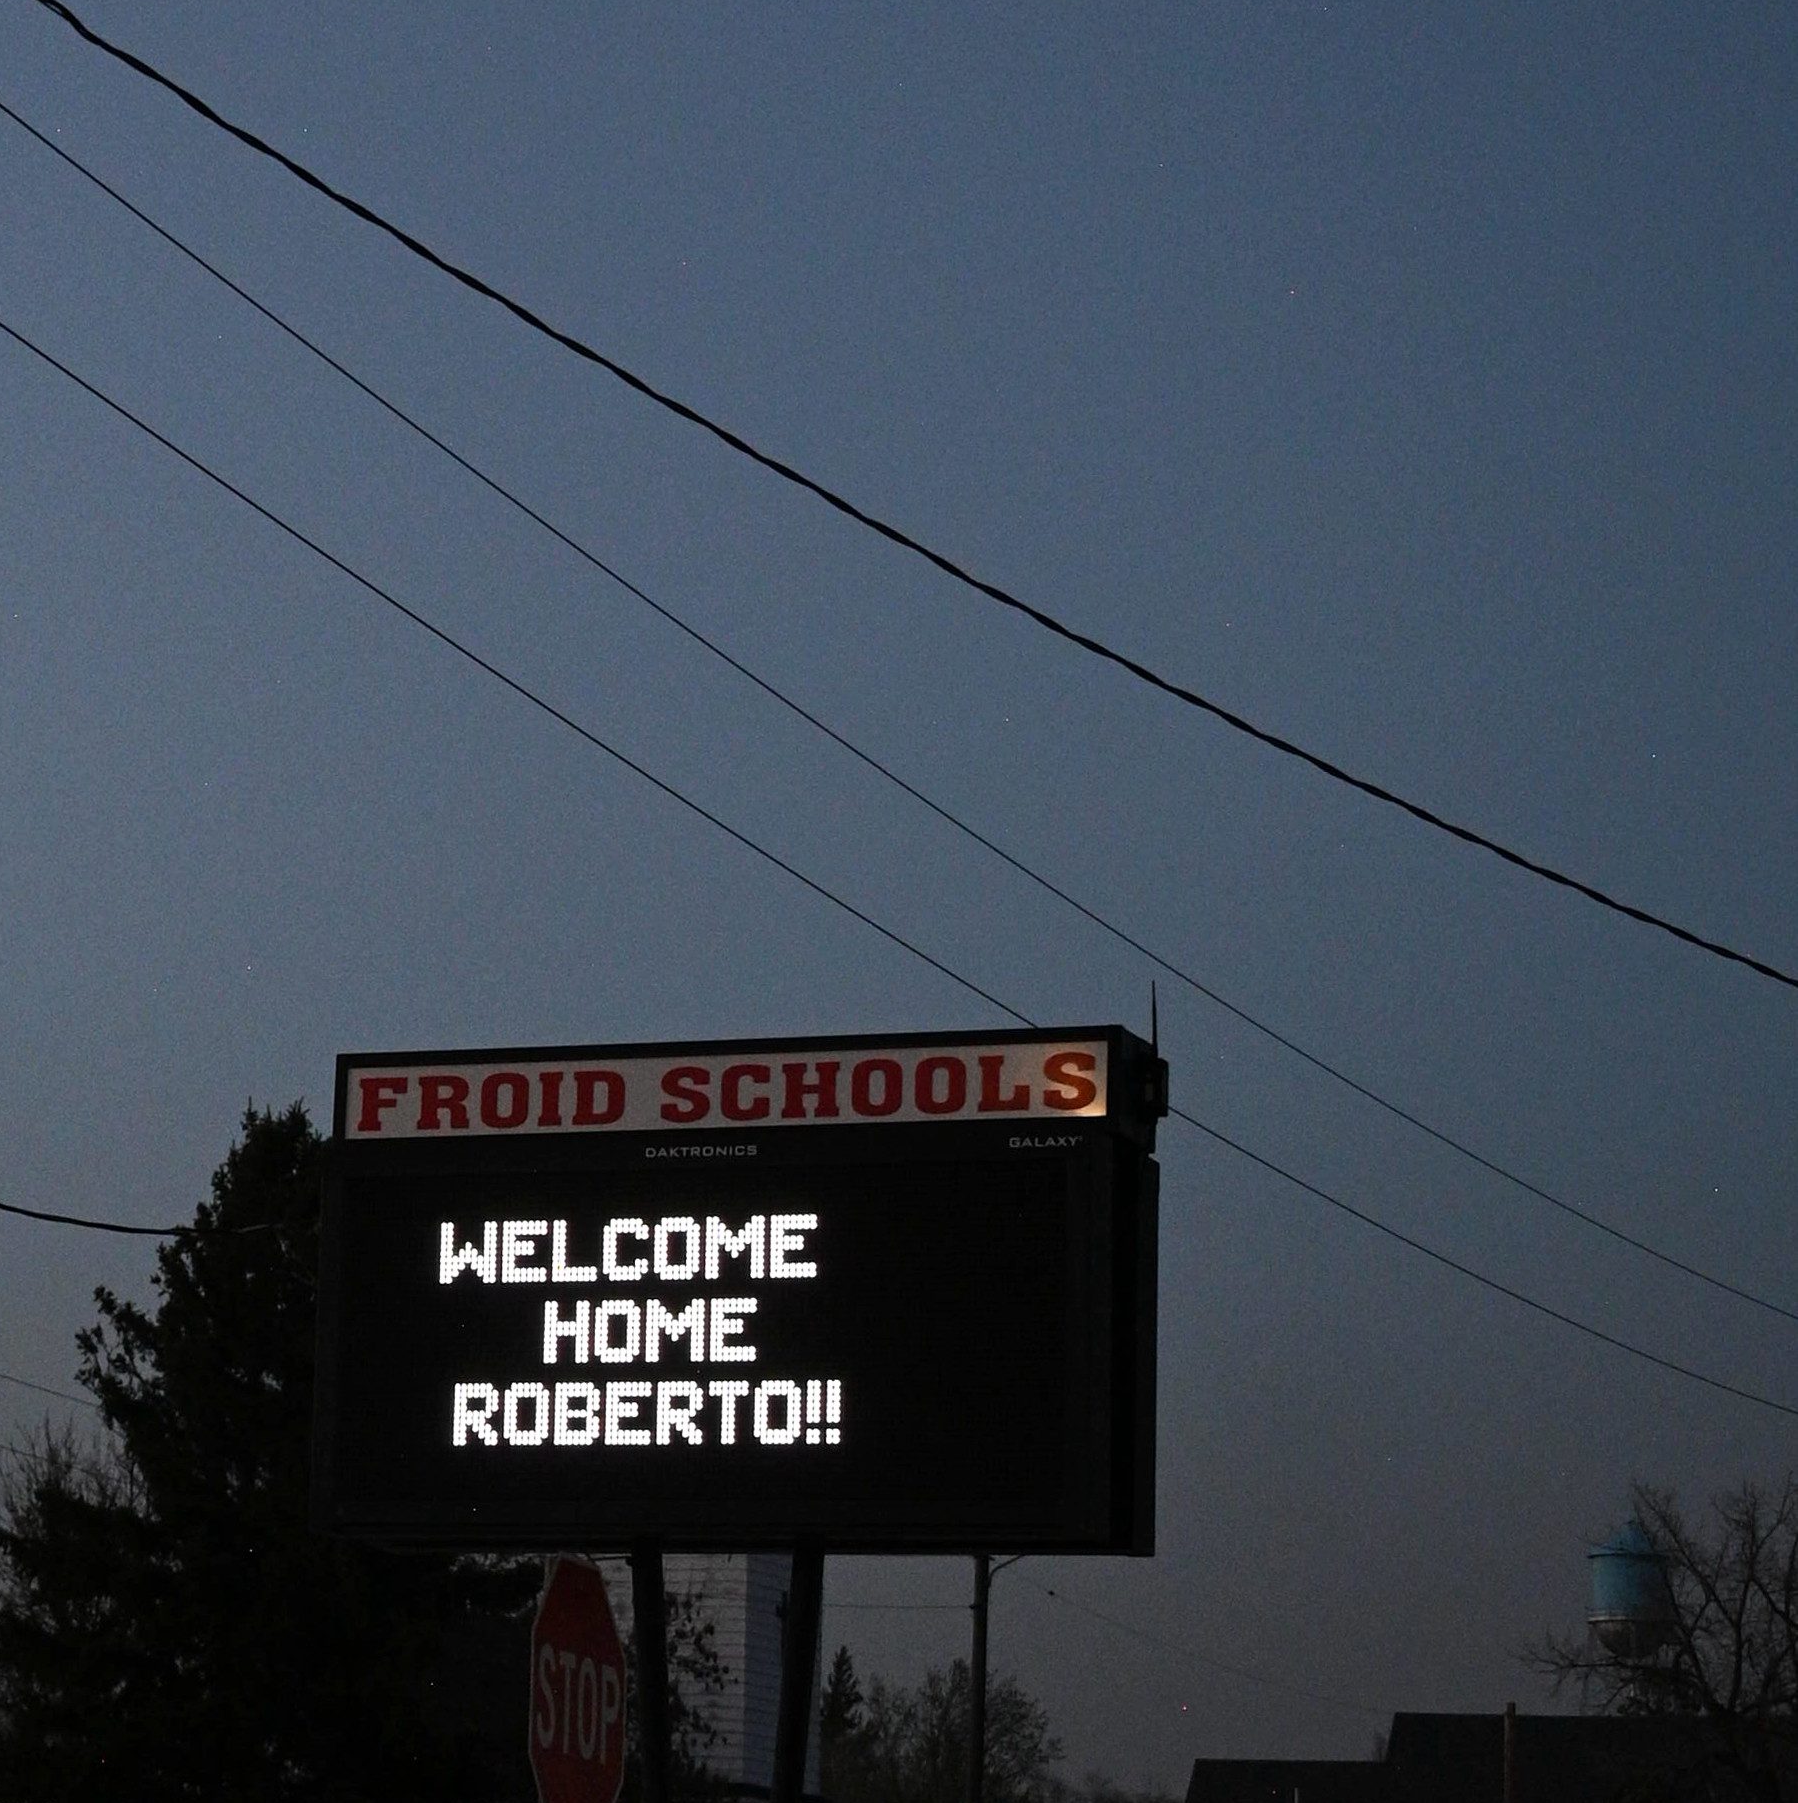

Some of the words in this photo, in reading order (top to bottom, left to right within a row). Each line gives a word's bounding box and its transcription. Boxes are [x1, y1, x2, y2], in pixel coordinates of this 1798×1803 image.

[357, 1070, 627, 1132] FROID
[659, 1051, 1098, 1124] SCHOOLS
[644, 1143, 759, 1160] DAKTRONICS
[1008, 1135, 1080, 1149] GALAXY
[439, 1214, 818, 1284] WELCOME
[543, 1298, 757, 1364] HOME
[453, 1380, 841, 1446] ROBERTO!!
[536, 1642, 620, 1765] STOP
